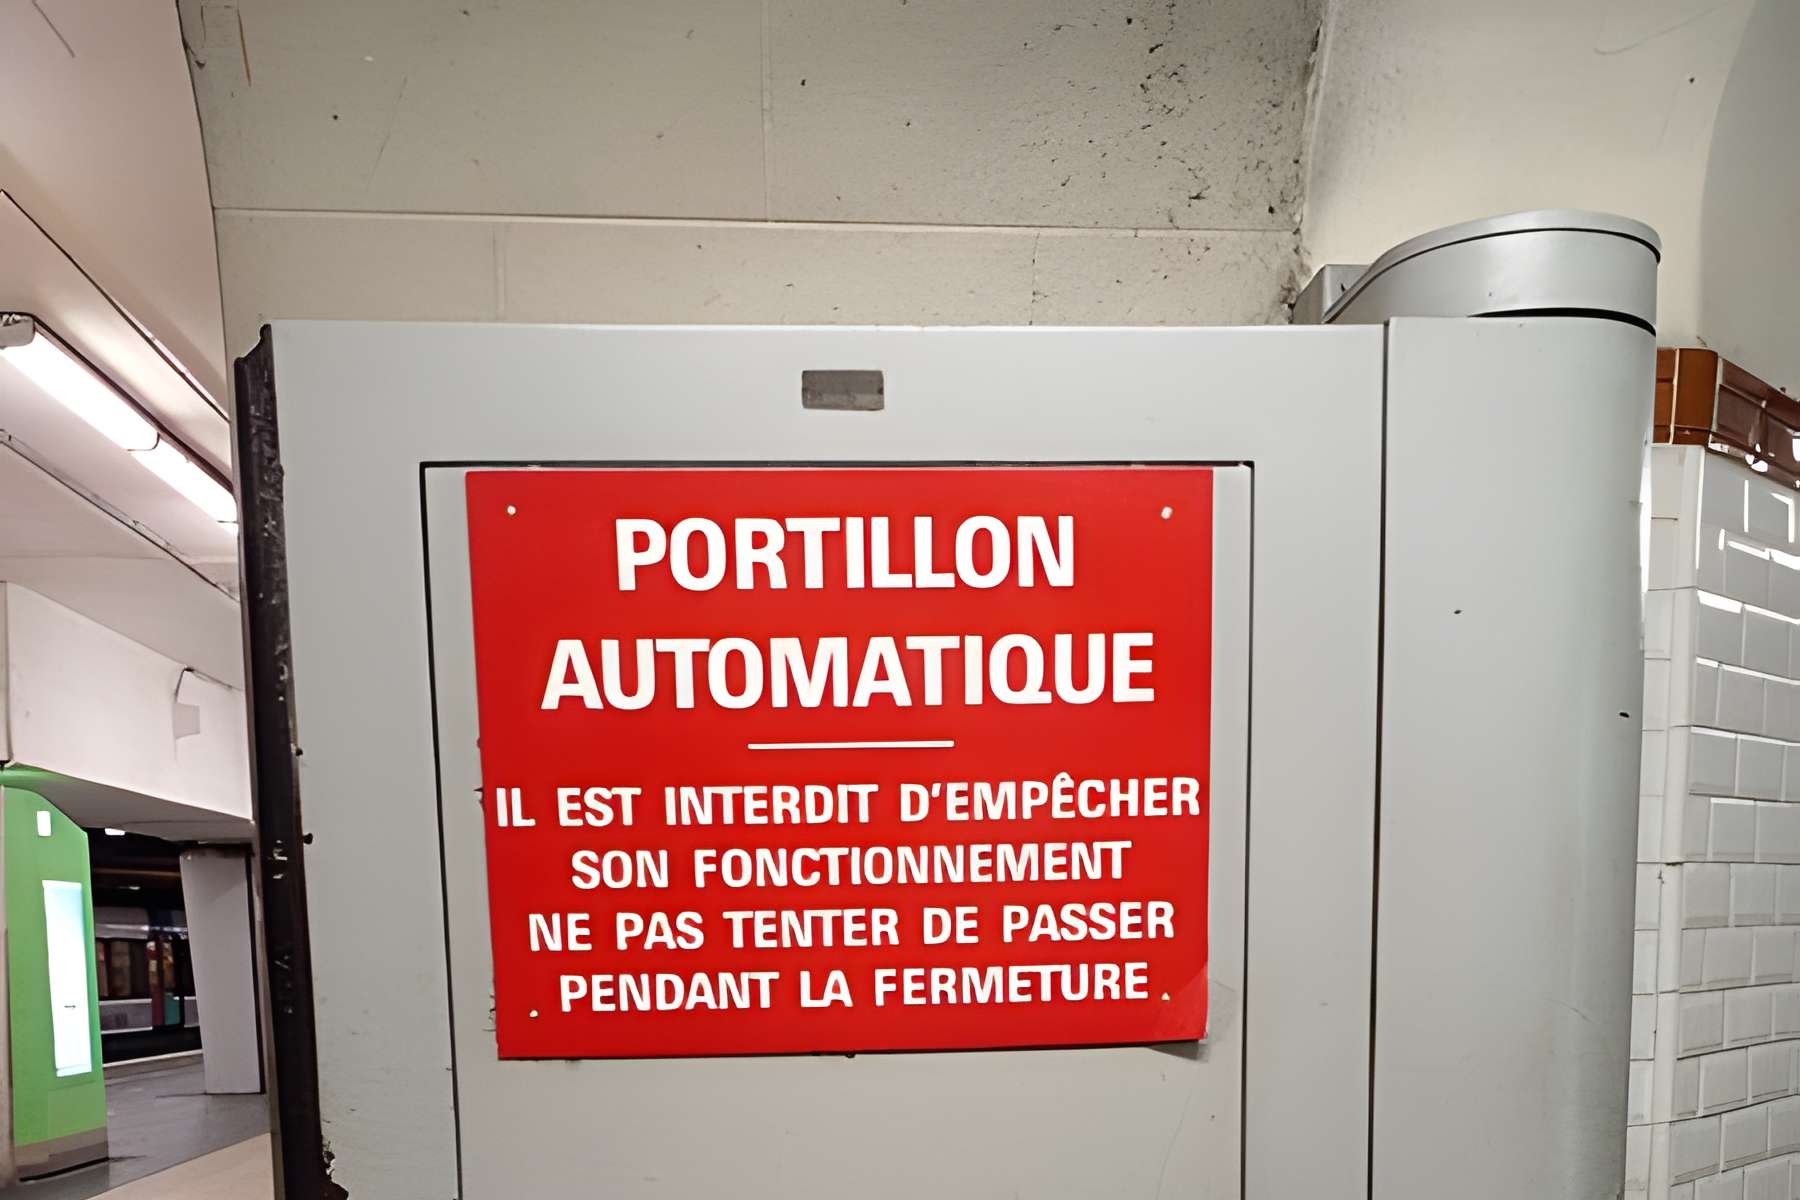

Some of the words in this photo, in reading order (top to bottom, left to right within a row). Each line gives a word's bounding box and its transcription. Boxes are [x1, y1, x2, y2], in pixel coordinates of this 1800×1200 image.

[615, 515, 1074, 592] PORTILLON
[540, 632, 1155, 711] AUTOMATIQUE
[496, 787, 536, 828] IL
[557, 786, 642, 827] EST
[664, 783, 879, 827] INTERDIT
[900, 771, 1200, 823] D'EMPÊCHER
[571, 849, 669, 890] SON
[694, 840, 1133, 888] FONCTIONNEMENT
[528, 912, 593, 952] NE
[616, 911, 705, 951] PAS
[722, 908, 900, 949] TENTER
[923, 906, 979, 946] DE
[1002, 900, 1175, 943] PASSER
[559, 971, 780, 1013] PENDANT
[799, 969, 853, 1009] LA
[874, 961, 1149, 1007] FERMETURE
